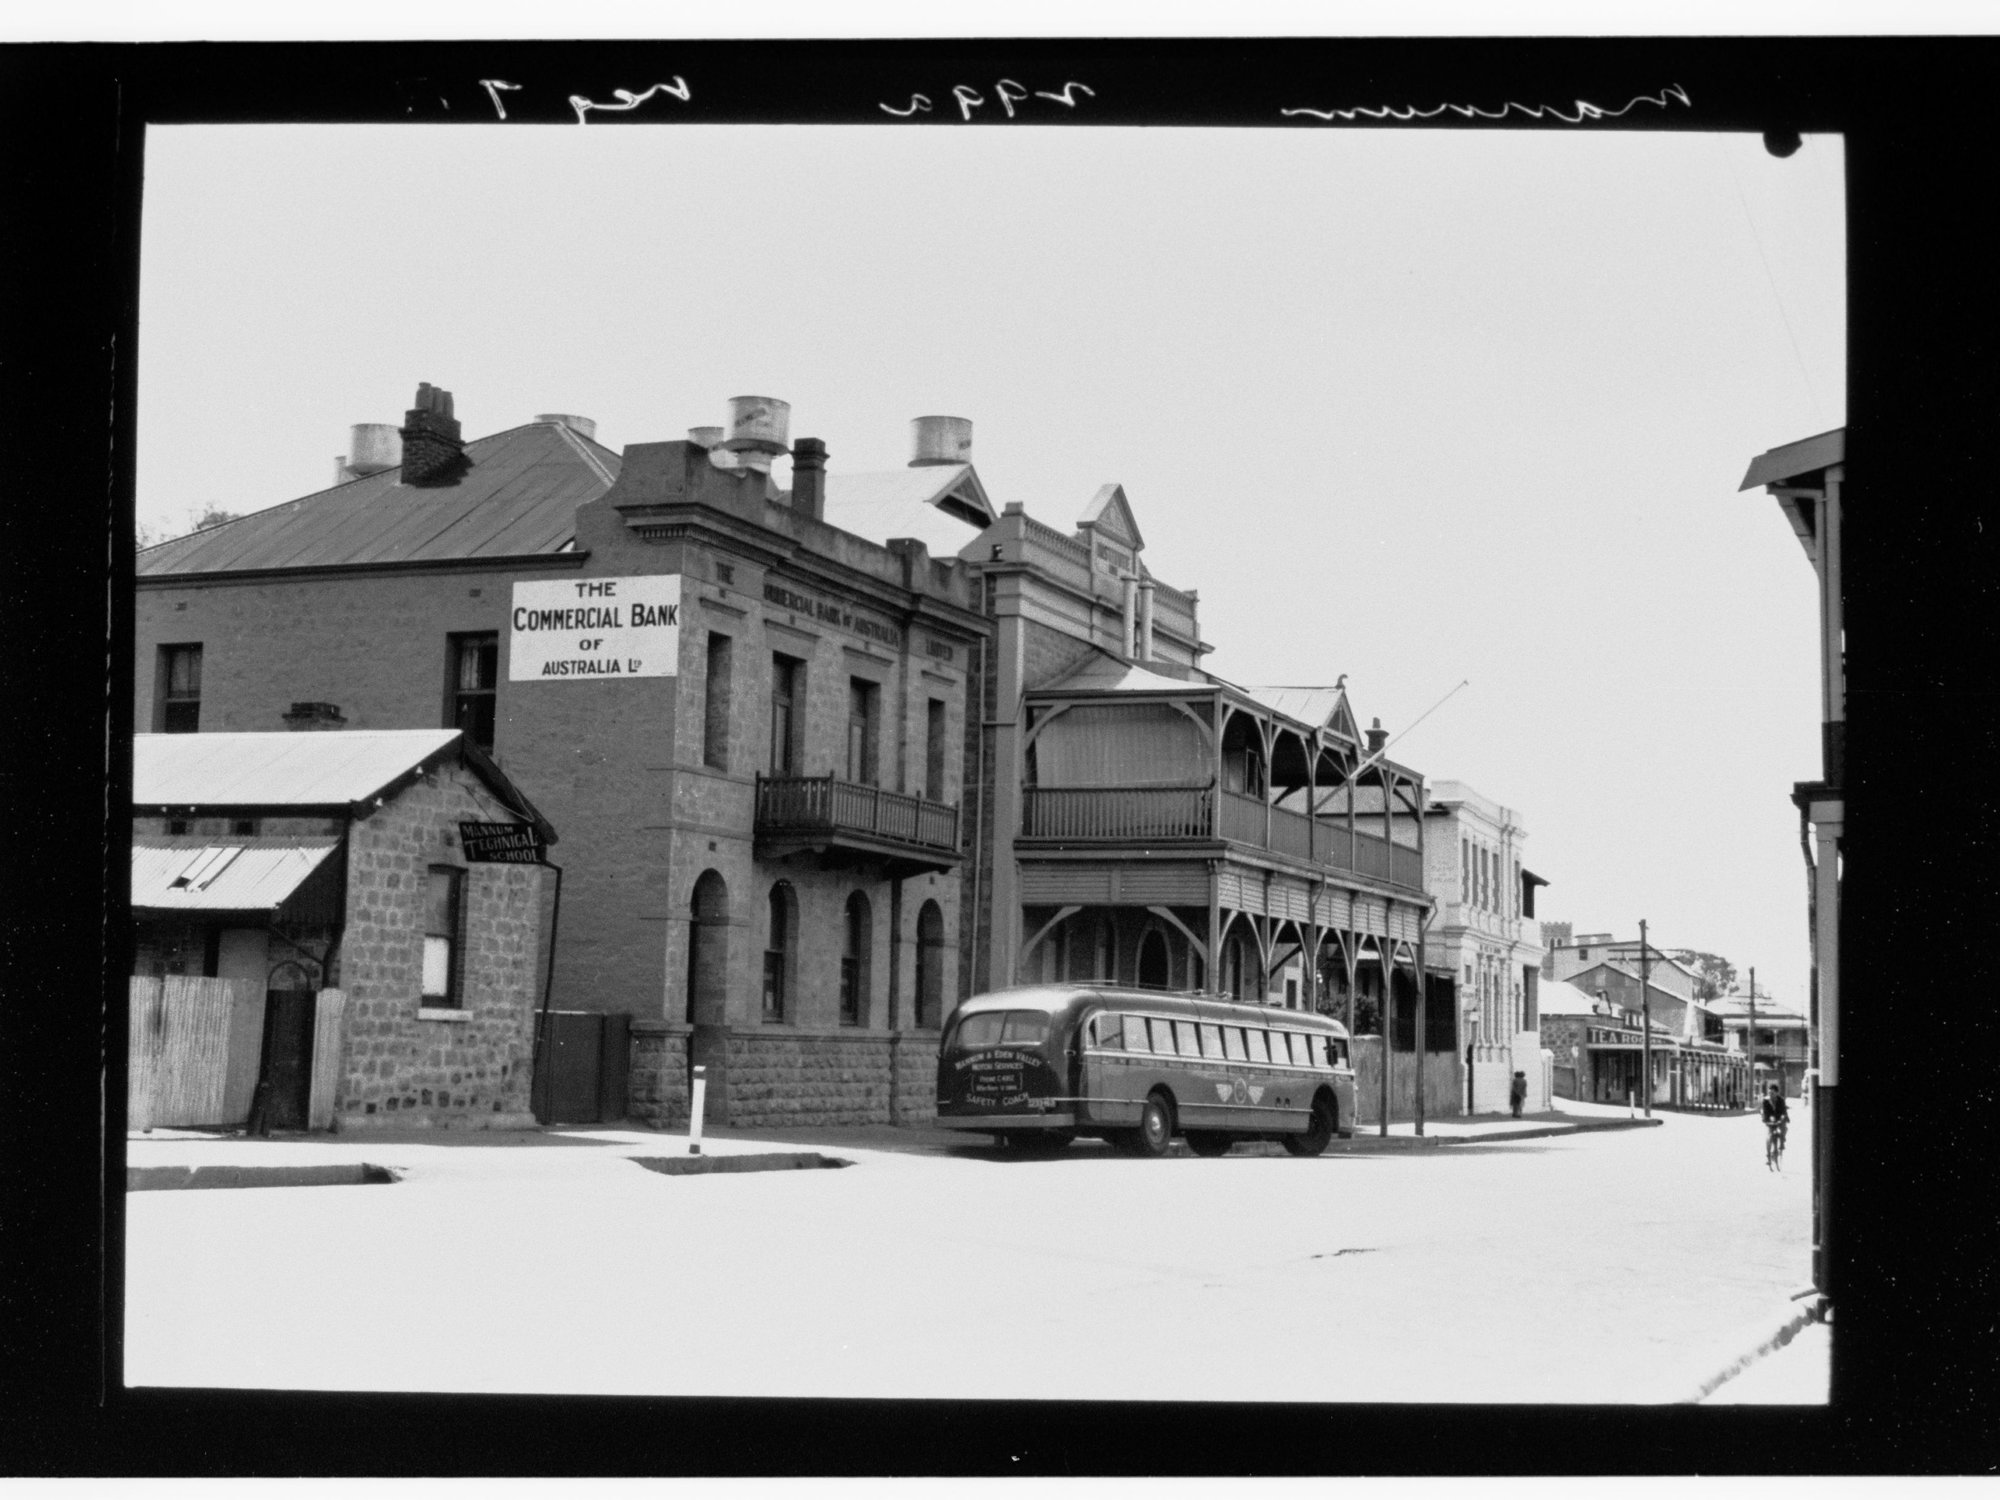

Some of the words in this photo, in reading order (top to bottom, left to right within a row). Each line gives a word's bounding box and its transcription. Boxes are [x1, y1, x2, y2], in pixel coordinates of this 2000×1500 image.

[575, 581, 617, 598] THE
[513, 606, 623, 632] COMMERCIAL
[630, 602, 679, 628] BANK
[579, 638, 604, 651] OF
[542, 659, 621, 676] AUSTRALIA
[462, 825, 514, 838] MANNUM
[464, 826, 539, 860] TECHNICAL
[489, 848, 541, 862] SCHOOL
[1590, 1028, 1618, 1044] TEA
[994, 1049, 1014, 1059] EDEN
[1015, 1051, 1042, 1068] VALLEY
[966, 1092, 996, 1106] SAFETY
[1002, 1091, 1030, 1107] COACH
